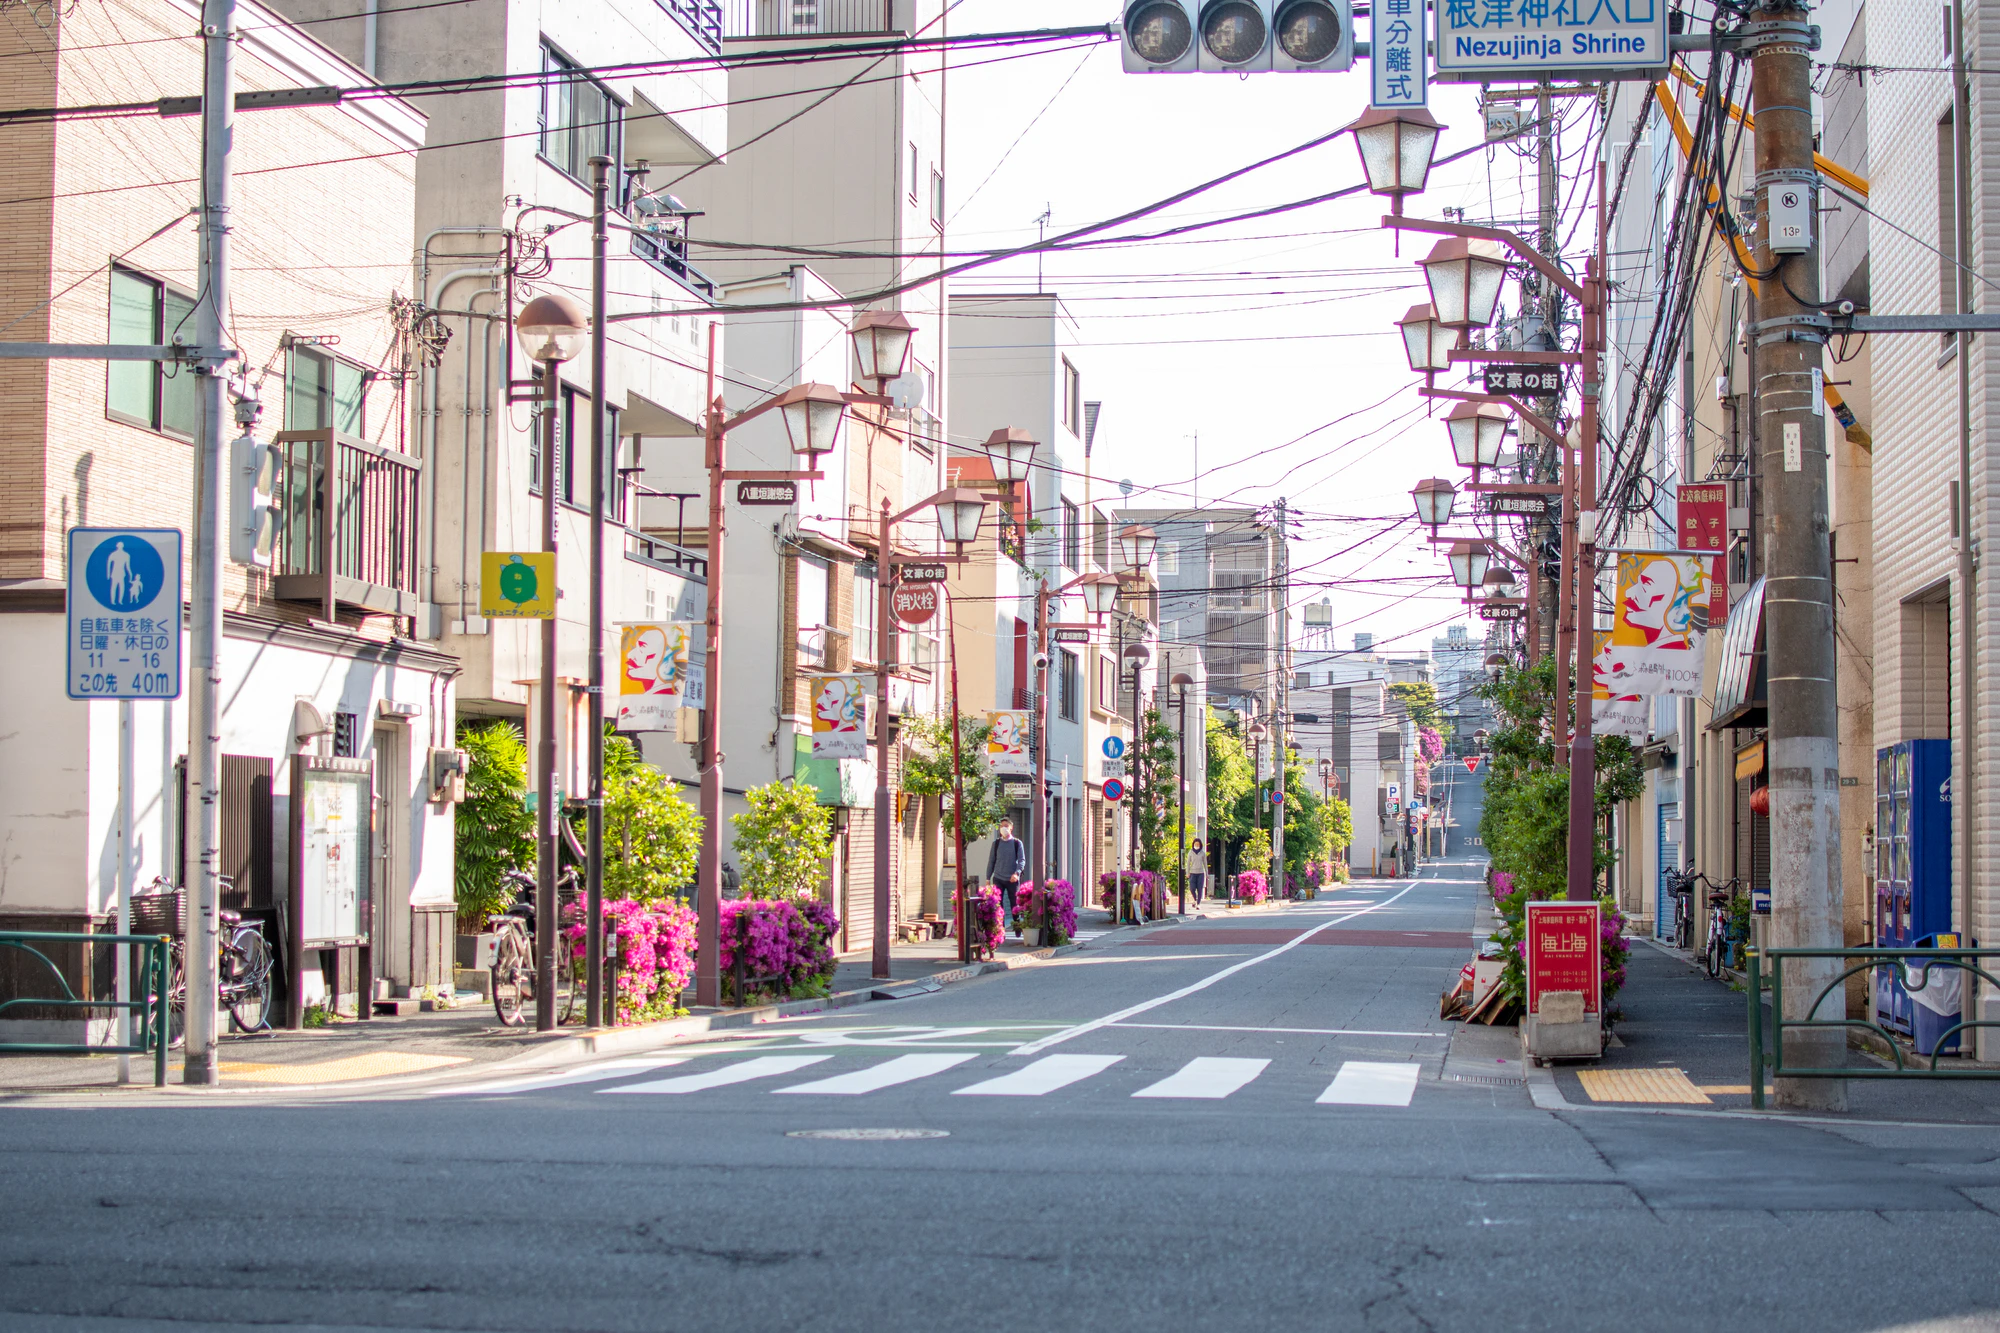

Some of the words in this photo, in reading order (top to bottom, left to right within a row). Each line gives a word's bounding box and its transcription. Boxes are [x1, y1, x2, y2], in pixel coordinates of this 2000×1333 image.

[1456, 34, 1562, 60] Nezujinja
[1572, 33, 1646, 55] Shrine
[1783, 226, 1800, 237] 13P
[1488, 372, 1558, 390] 文豪の街
[740, 487, 794, 500] 八重垣謝恩会
[1679, 489, 1724, 502] 上海家庭料理
[1493, 499, 1545, 512] 八重垣謝恩会
[903, 568, 945, 579] 文豪の街
[896, 592, 935, 612] 消火栓
[1482, 608, 1518, 617] 文豪の街
[80, 618, 169, 633] 自転車を除く
[80, 635, 169, 650] 日曜・休日の
[89, 653, 103, 668] 11
[142, 653, 160, 668] 16
[80, 673, 117, 693] この先
[132, 673, 169, 693] 40m
[1389, 786, 1397, 797] P
[1463, 837, 1483, 846] 30
[1541, 932, 1588, 952] 海上海
